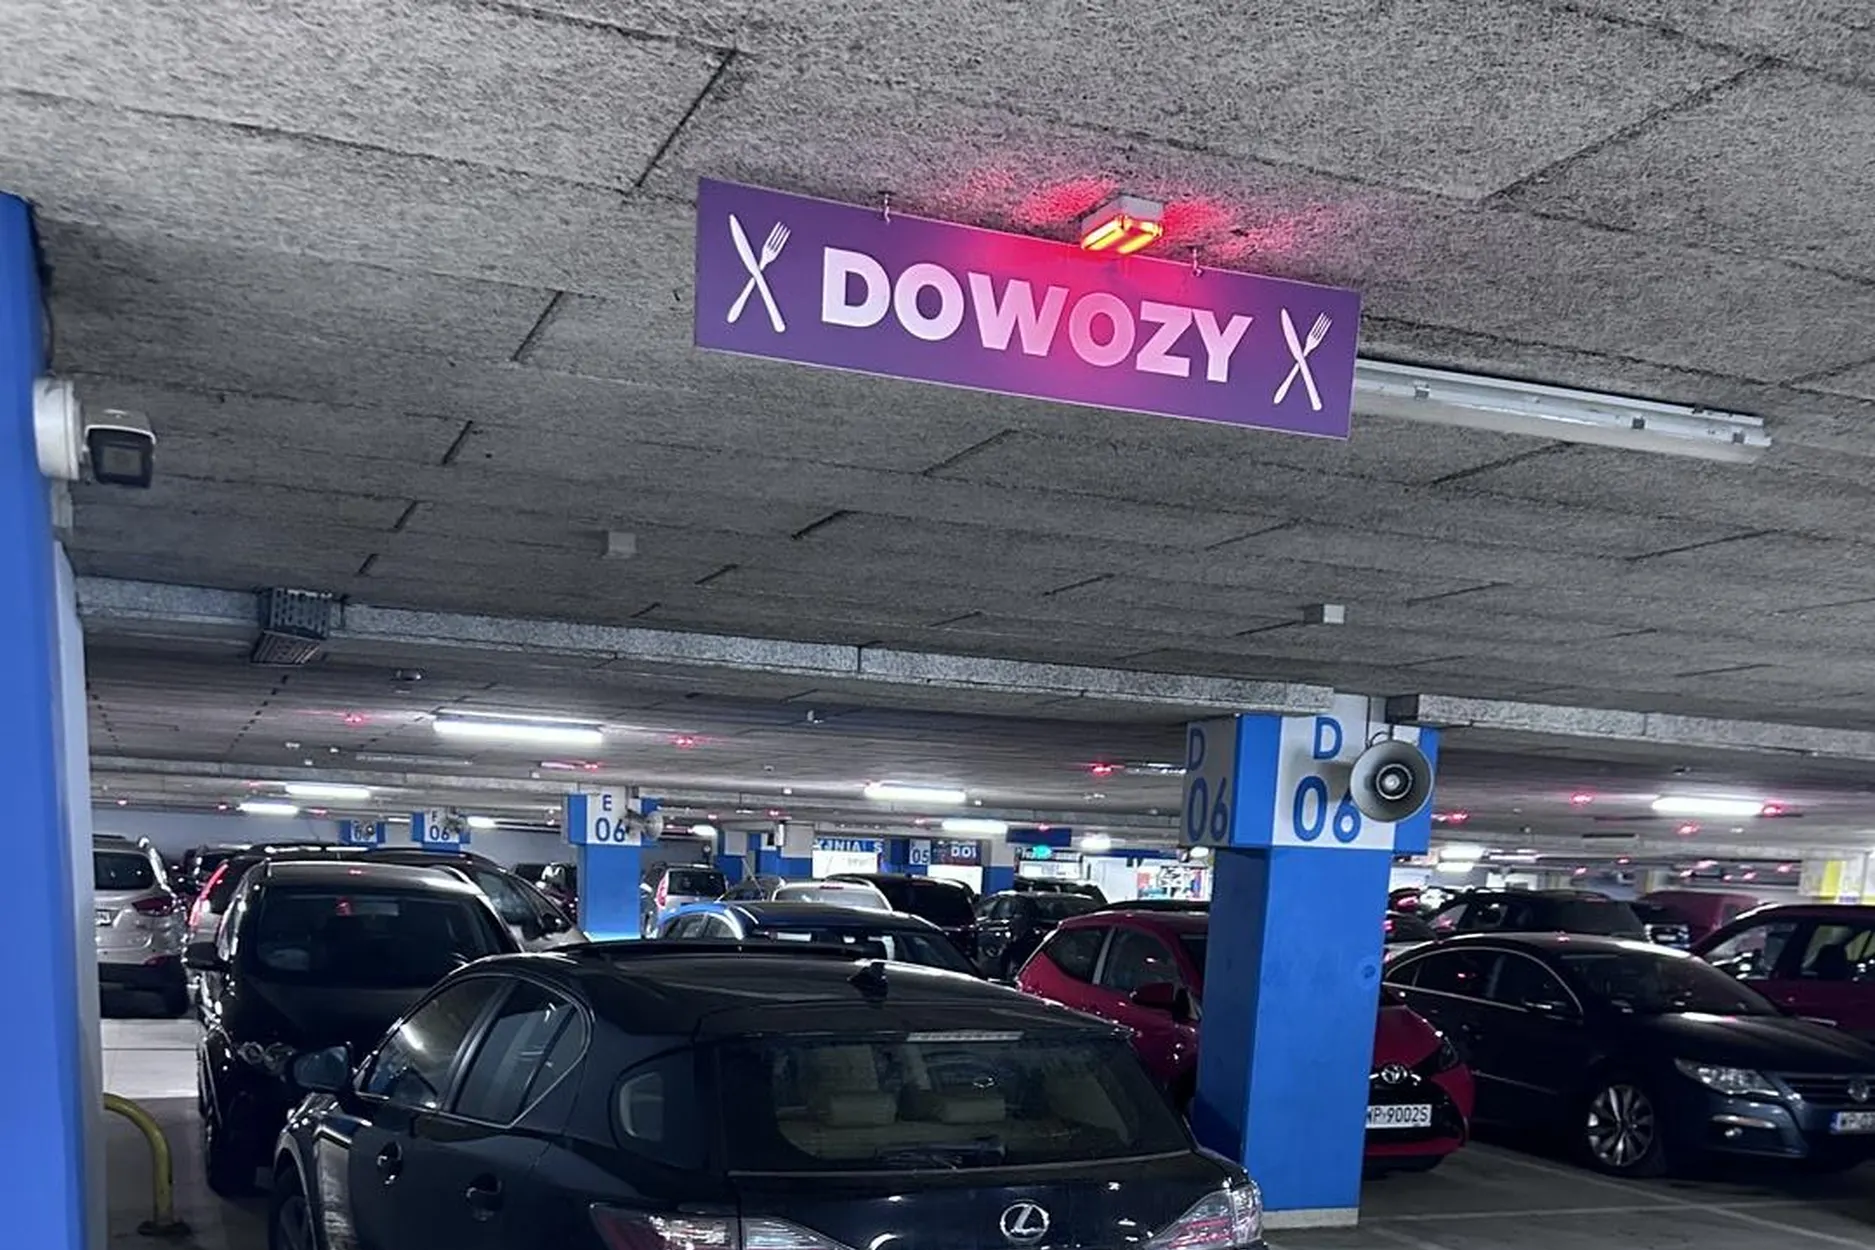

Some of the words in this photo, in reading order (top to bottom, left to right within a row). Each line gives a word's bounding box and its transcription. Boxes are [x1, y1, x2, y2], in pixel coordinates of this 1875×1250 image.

[822, 245, 1252, 383] DOWOZY
[1190, 727, 1206, 771] D
[1315, 716, 1343, 760] D
[602, 794, 612, 812] E
[1187, 777, 1228, 842] 06
[1293, 775, 1362, 843] 06
[430, 825, 451, 841] 06
[595, 817, 626, 843] 06
[911, 848, 930, 864] 05
